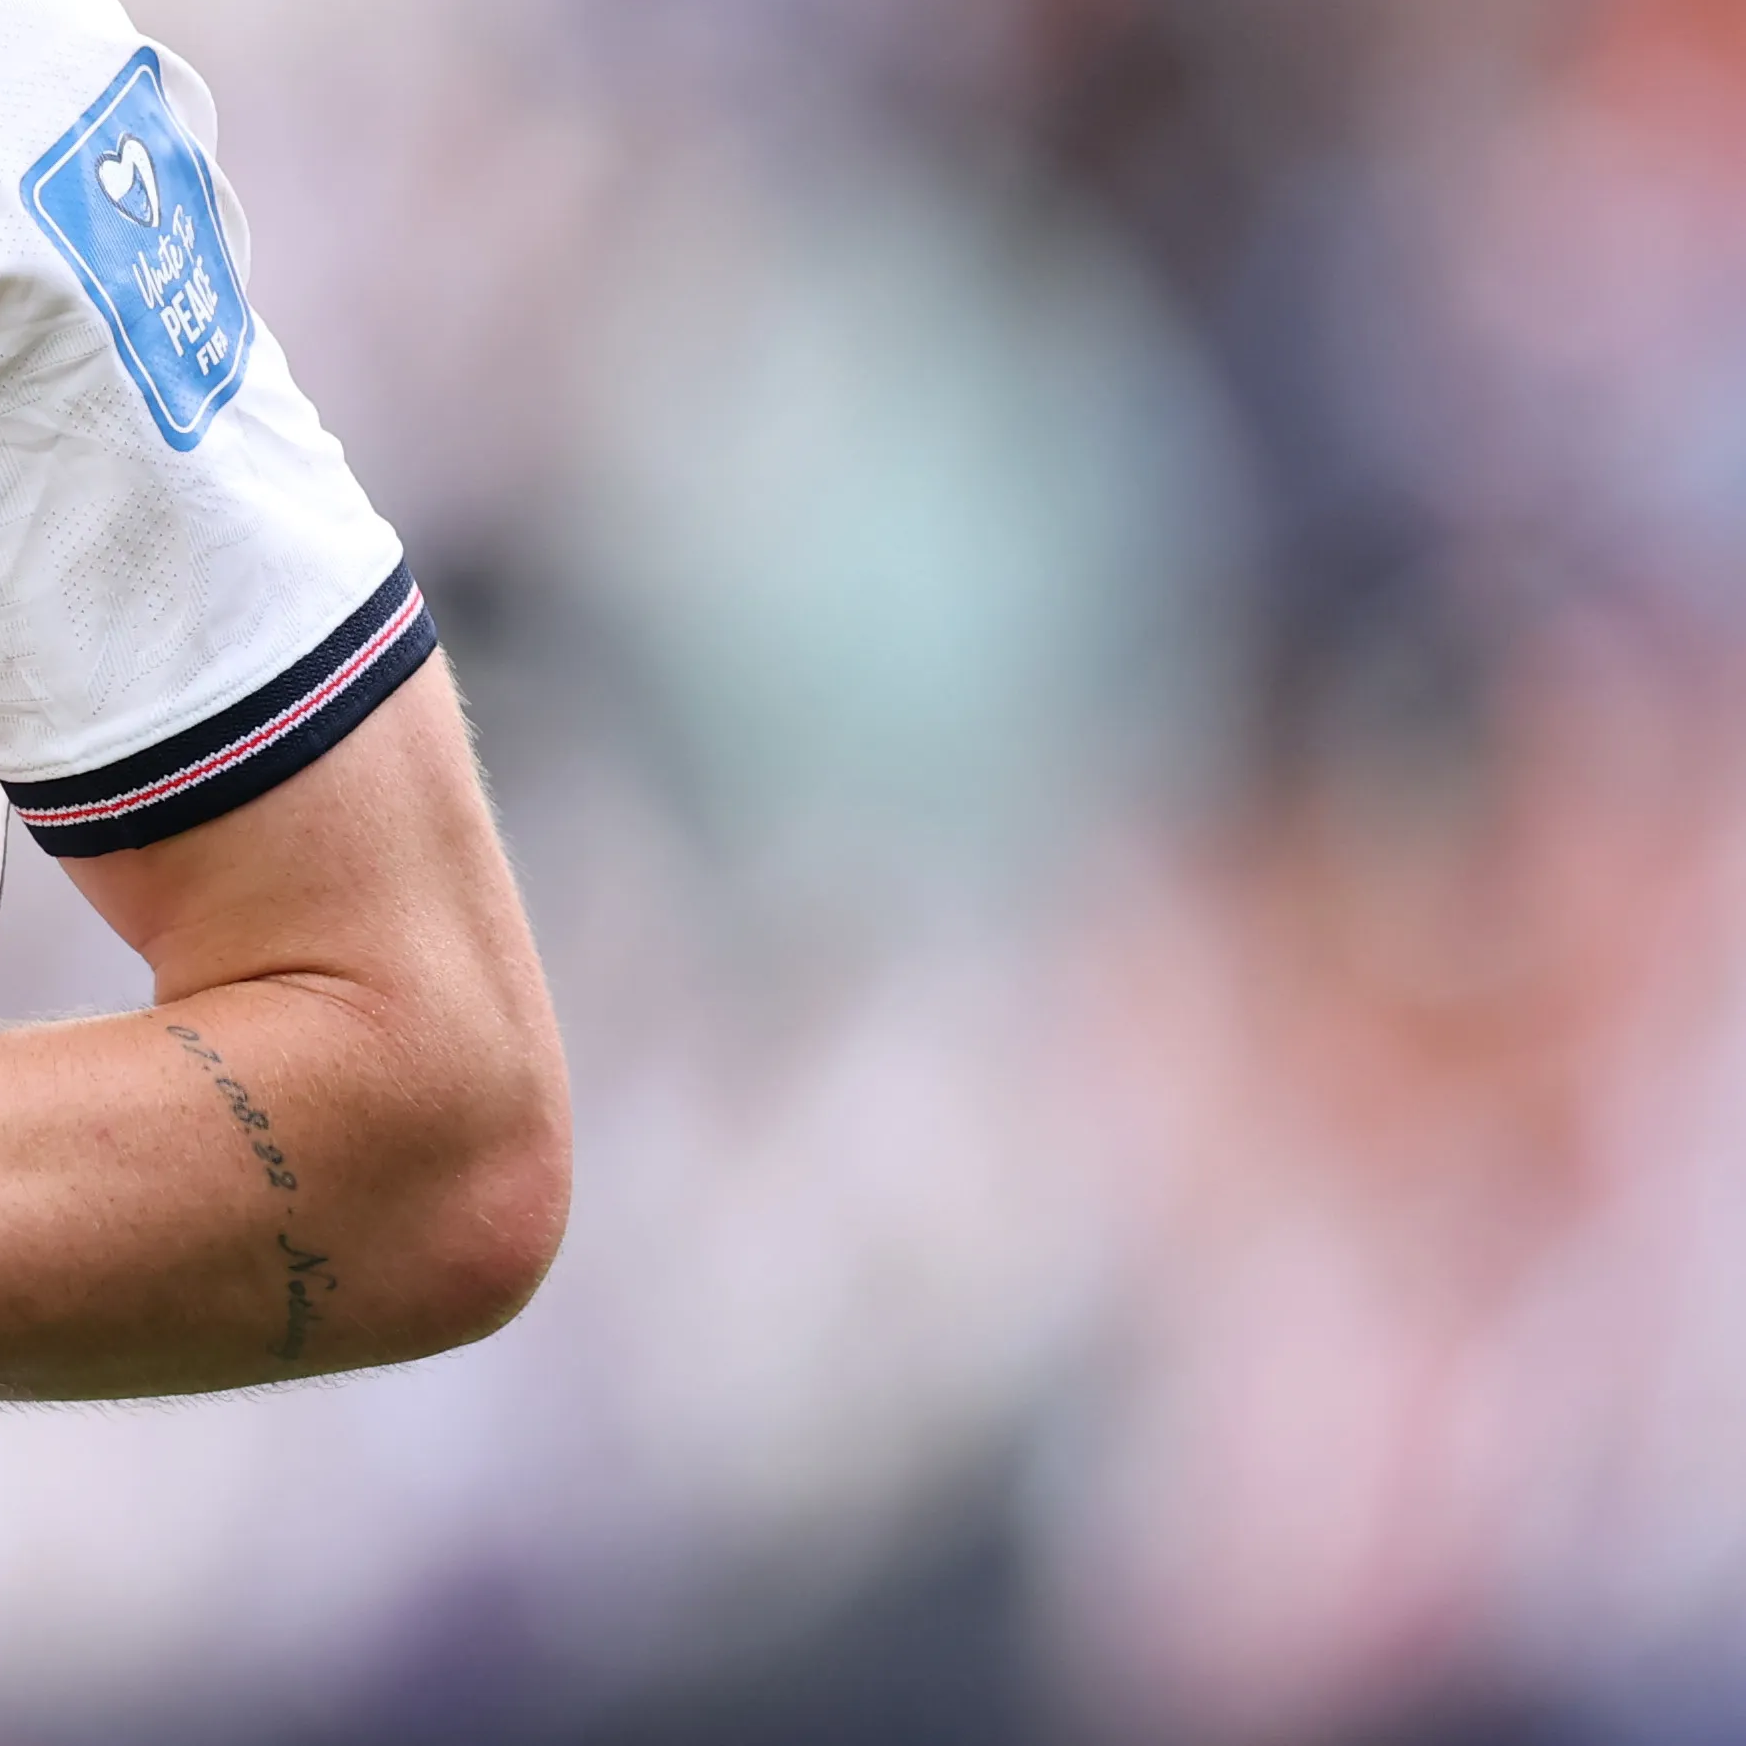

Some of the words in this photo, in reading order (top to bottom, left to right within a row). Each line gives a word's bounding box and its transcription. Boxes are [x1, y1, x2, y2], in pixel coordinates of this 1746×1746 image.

[132, 235, 184, 309] Unite
[160, 255, 218, 358] PEACE
[196, 326, 228, 376] FIFA
